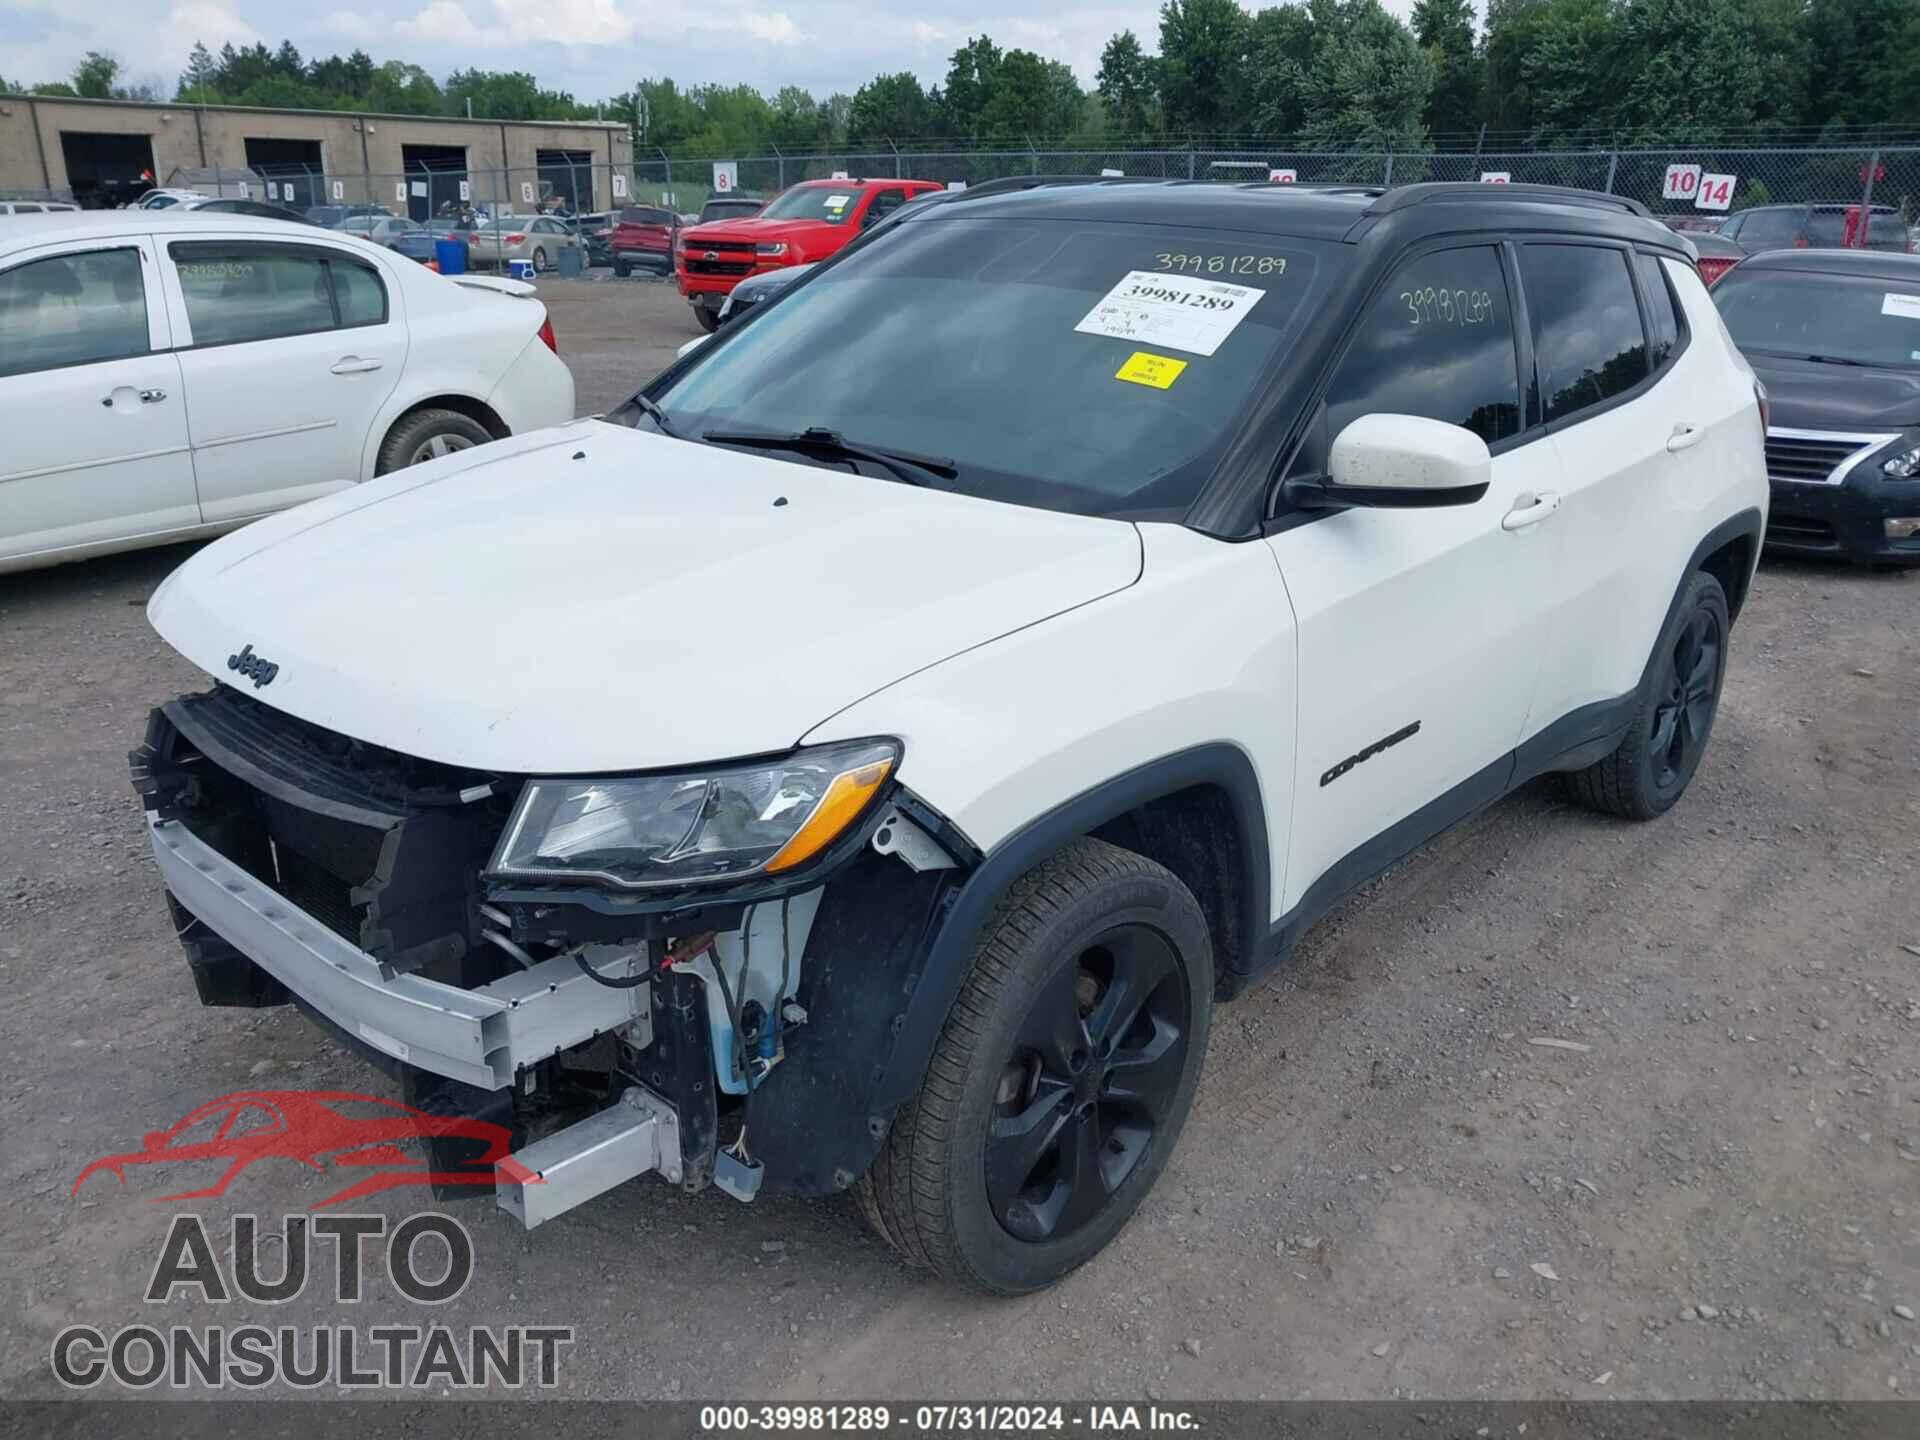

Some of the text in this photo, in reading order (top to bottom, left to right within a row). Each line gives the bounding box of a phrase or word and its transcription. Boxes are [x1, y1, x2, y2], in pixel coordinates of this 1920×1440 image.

[616, 179, 623, 192] 7
[719, 174, 727, 188] 8
[1669, 172, 1696, 192] 10
[1703, 181, 1728, 204] 14
[1154, 253, 1286, 275] 39981289
[1123, 285, 1234, 312] 39981289
[1401, 287, 1494, 327] 39981289
[227, 644, 279, 690] Jeep
